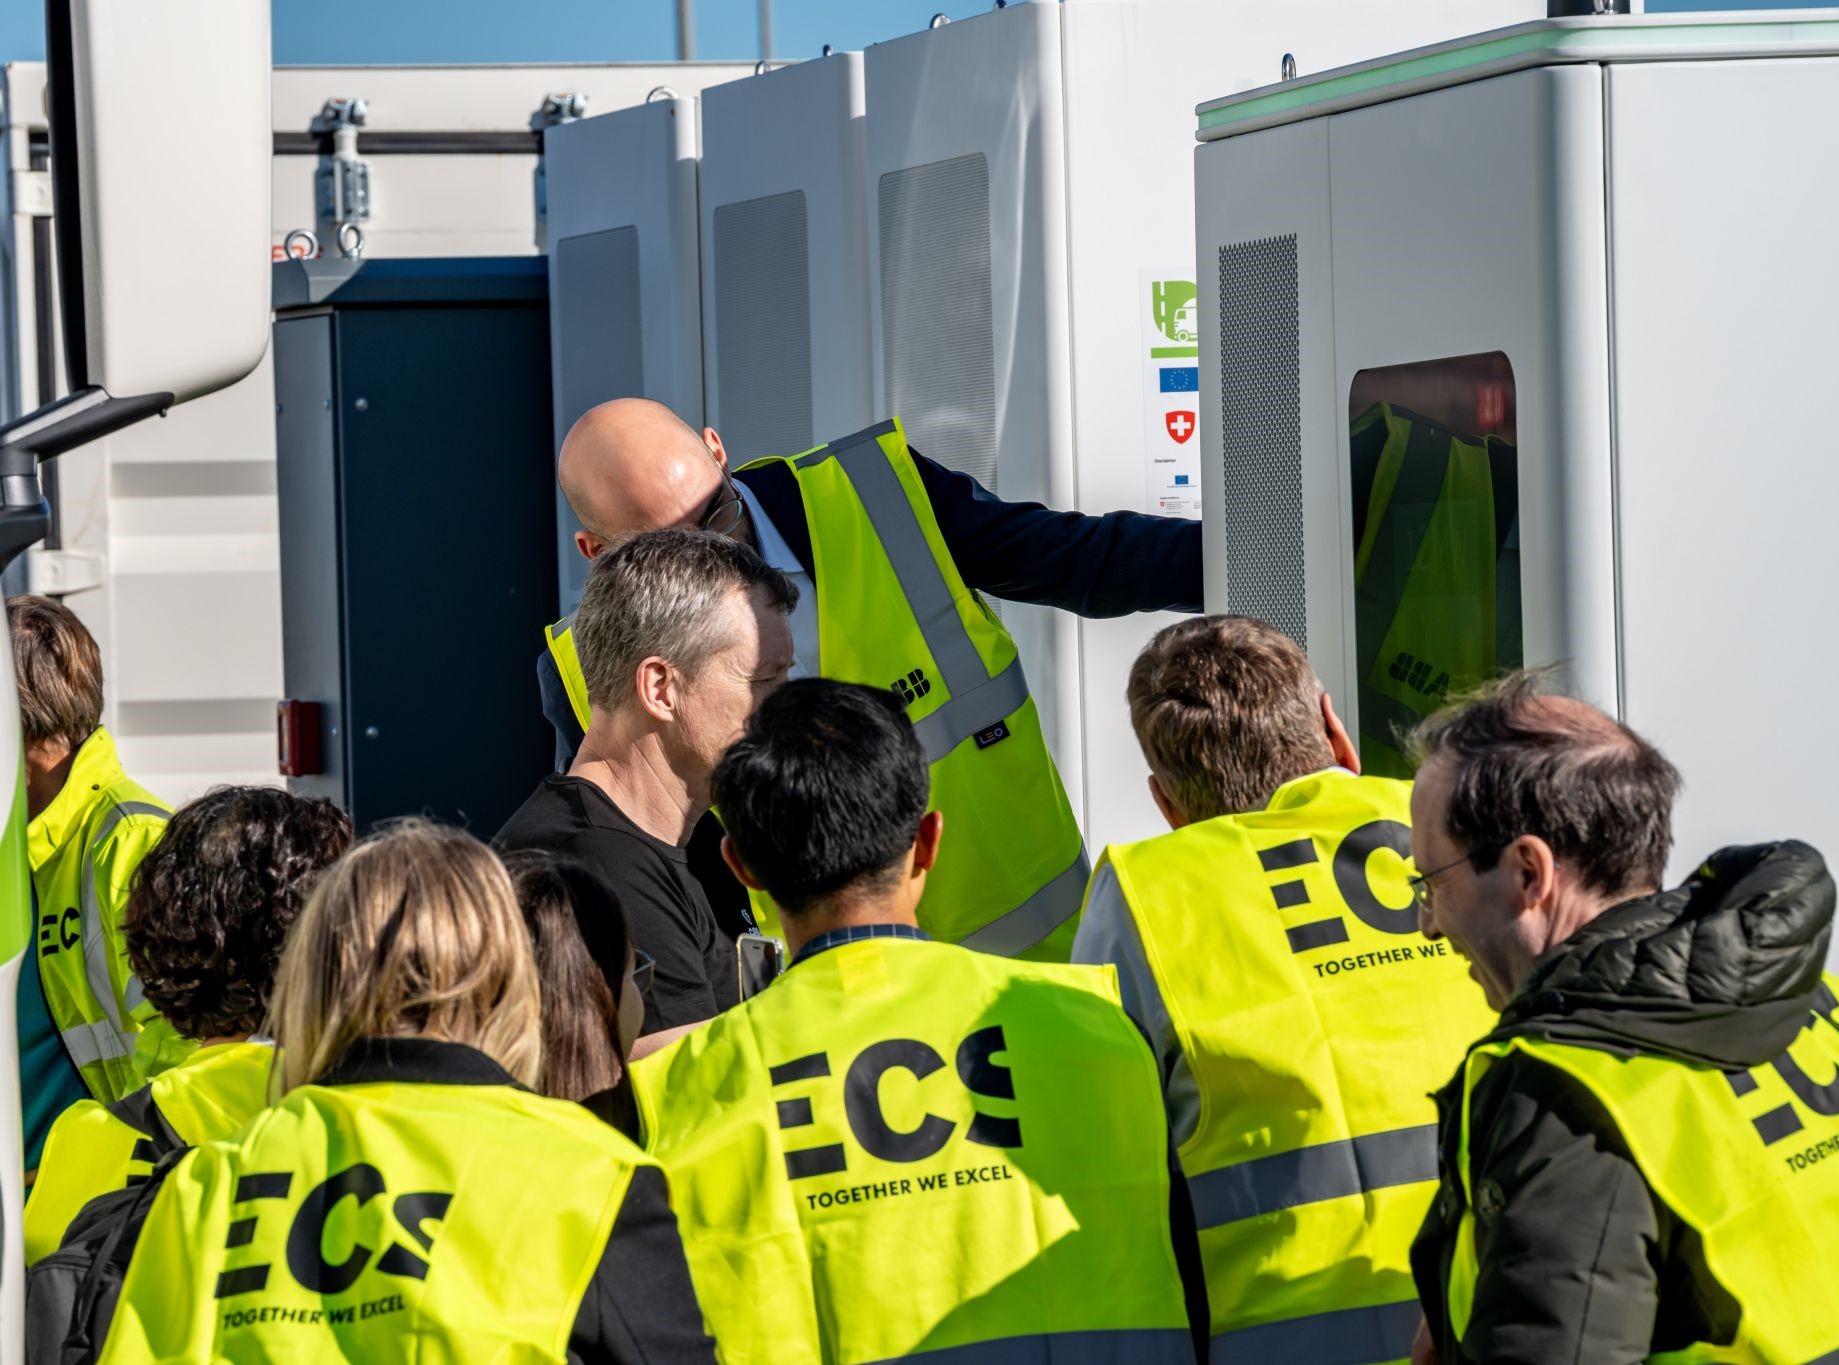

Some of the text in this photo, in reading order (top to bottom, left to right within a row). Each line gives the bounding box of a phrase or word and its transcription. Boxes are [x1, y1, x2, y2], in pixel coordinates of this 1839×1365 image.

[1257, 819, 1423, 954] EC
[41, 907, 81, 957] EC
[1313, 942, 1447, 978] TOGETHER WE
[769, 1024, 1024, 1181] ECS
[806, 1165, 1012, 1210] TOGETHER WE EXCEL
[214, 1162, 455, 1300] ECS
[223, 1295, 405, 1330] TOGETHER WE EXCEL
